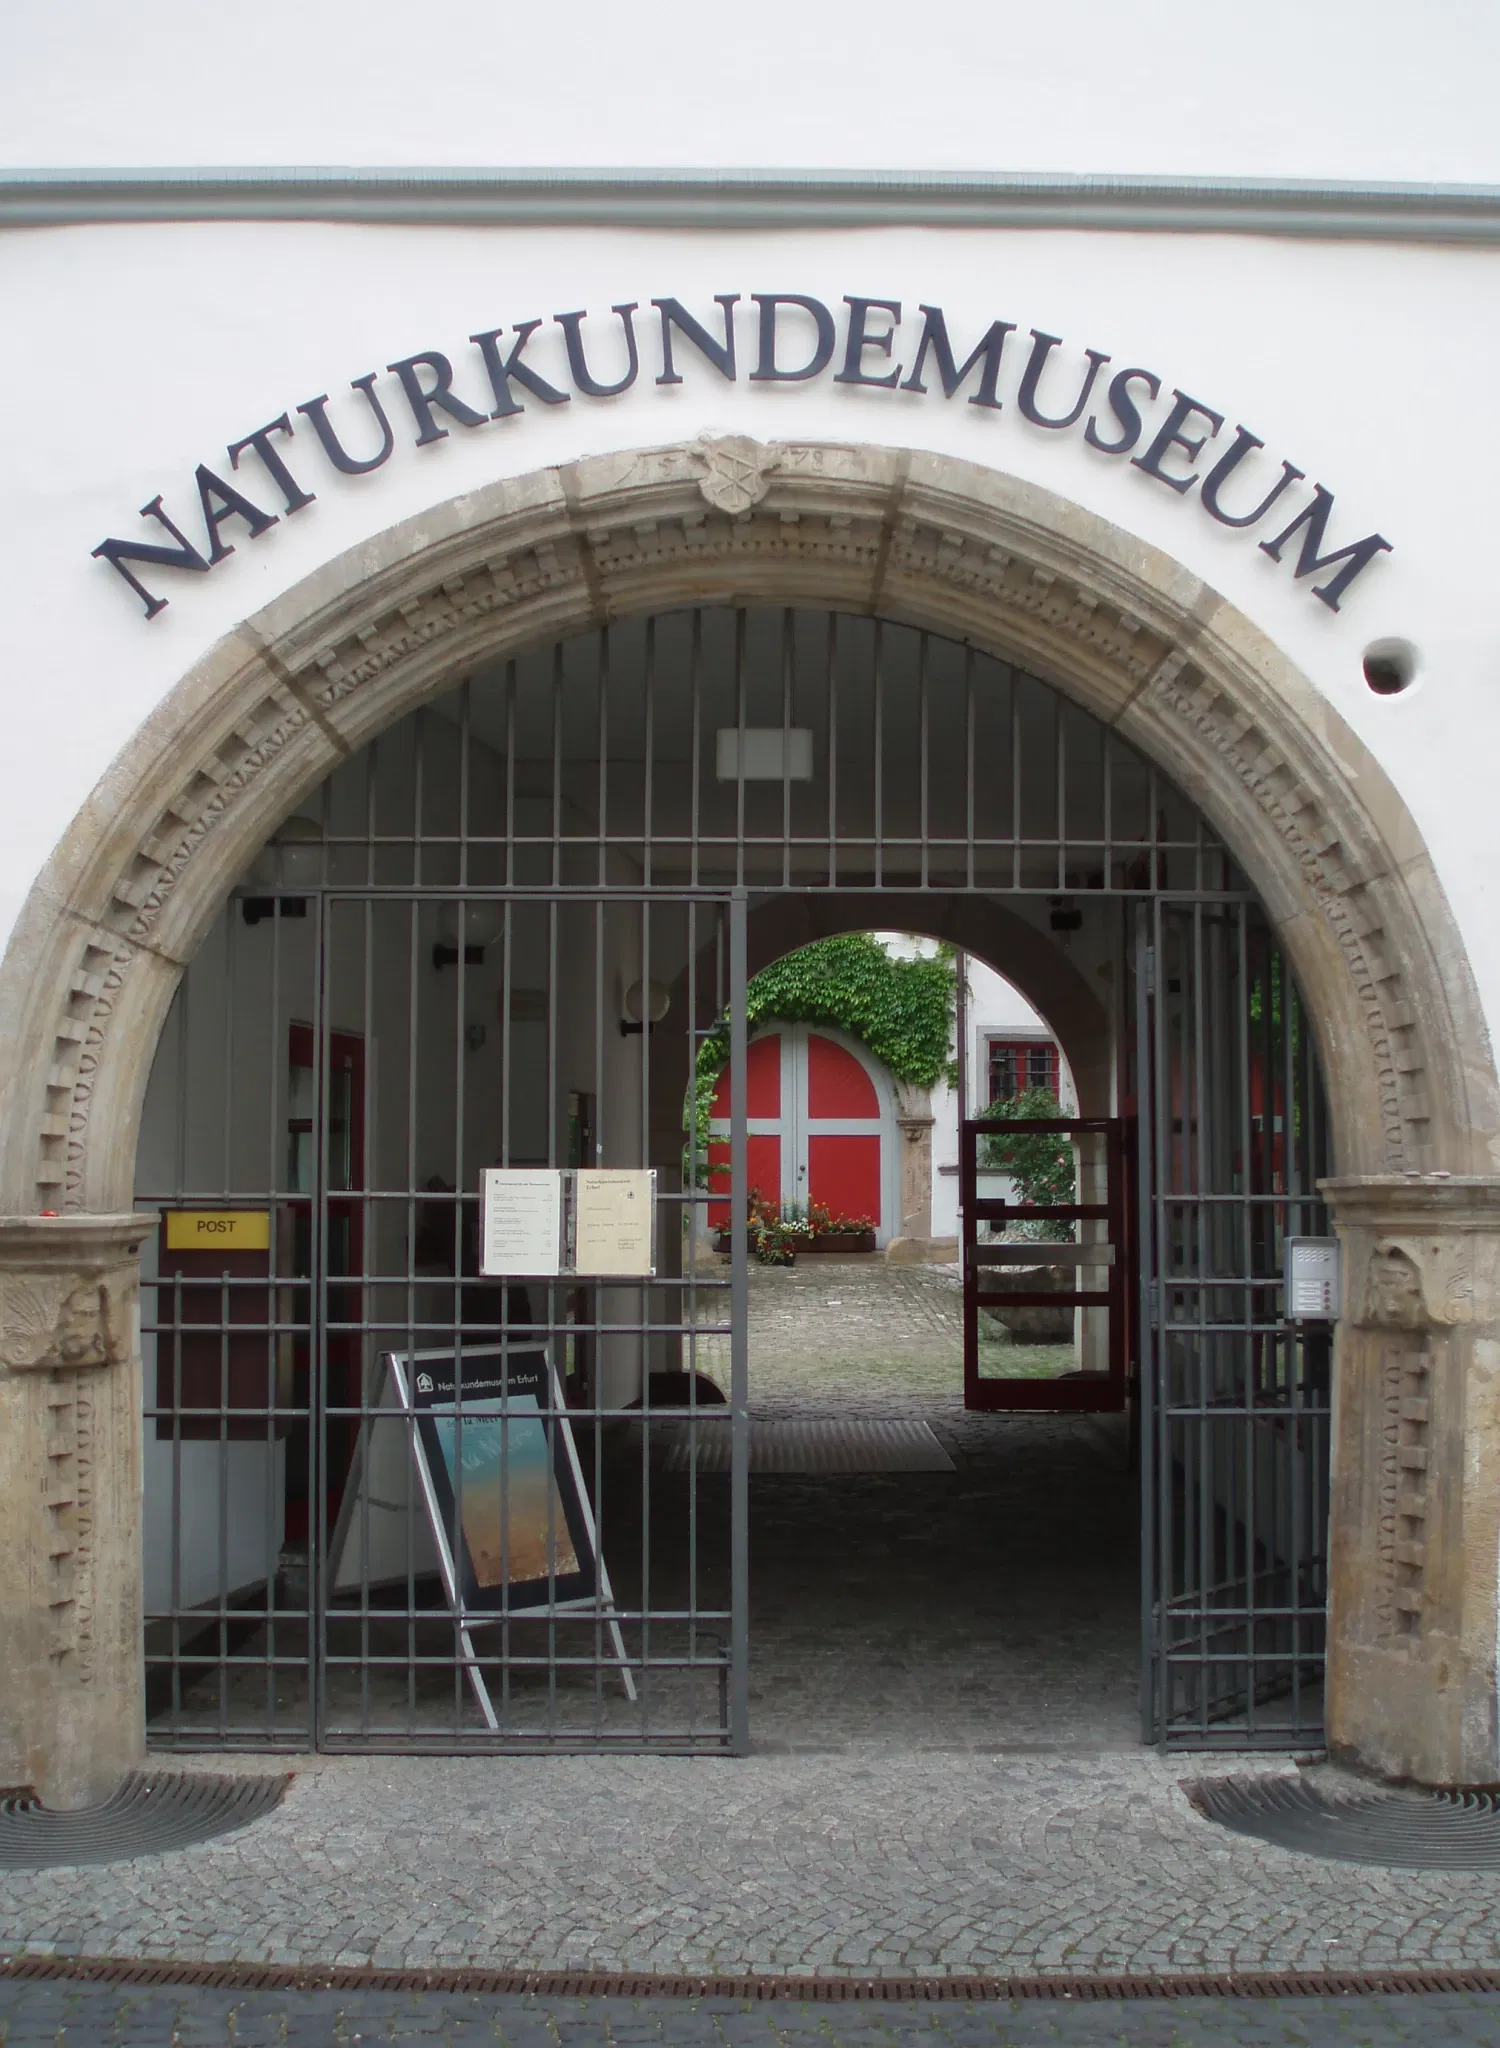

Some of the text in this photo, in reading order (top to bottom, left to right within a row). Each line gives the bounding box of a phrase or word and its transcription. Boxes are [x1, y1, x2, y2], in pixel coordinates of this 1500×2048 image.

[91, 293, 1394, 620] NATURKUNDEMUSEUM
[197, 1220, 236, 1232] POST
[517, 1373, 538, 1384] Erfurt
